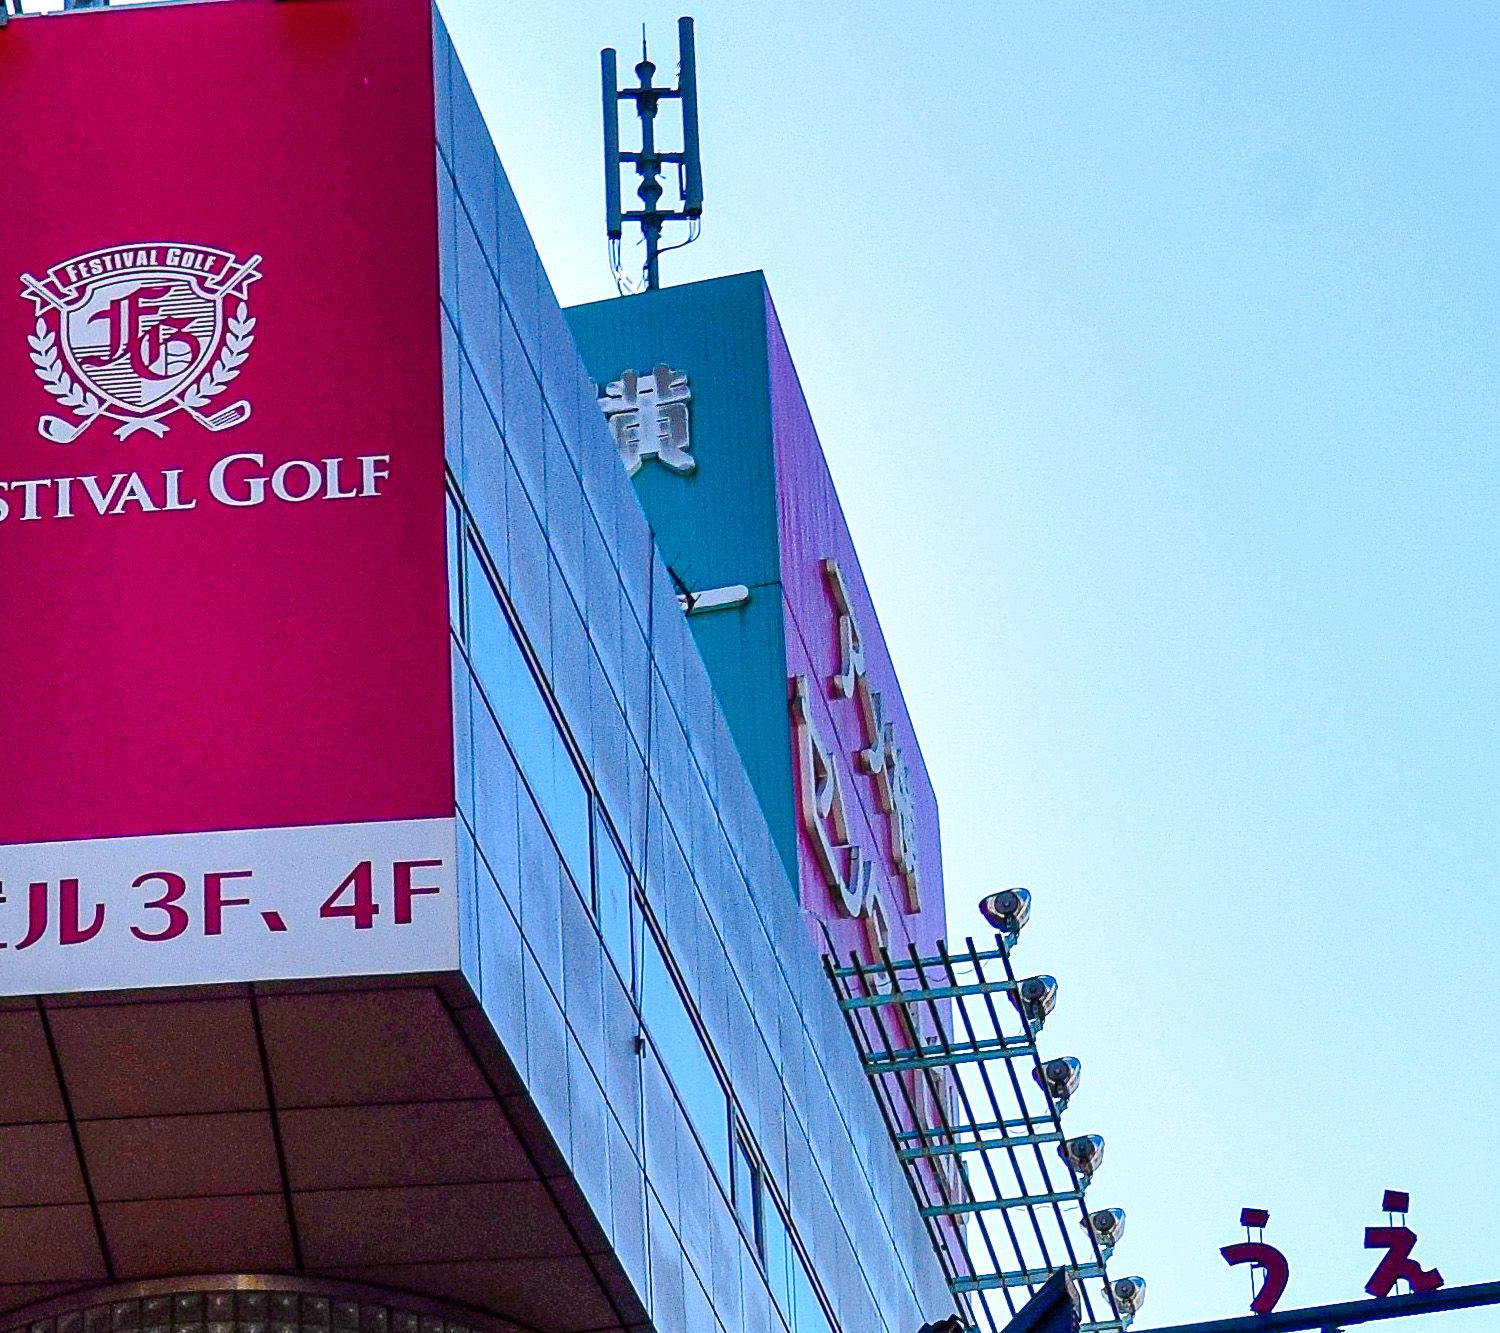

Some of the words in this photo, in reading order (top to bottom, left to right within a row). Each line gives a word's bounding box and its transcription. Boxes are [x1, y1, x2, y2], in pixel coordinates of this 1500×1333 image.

[66, 249, 159, 282] FESTIVAL
[165, 247, 217, 272] GOLF
[209, 453, 391, 507] GOLF
